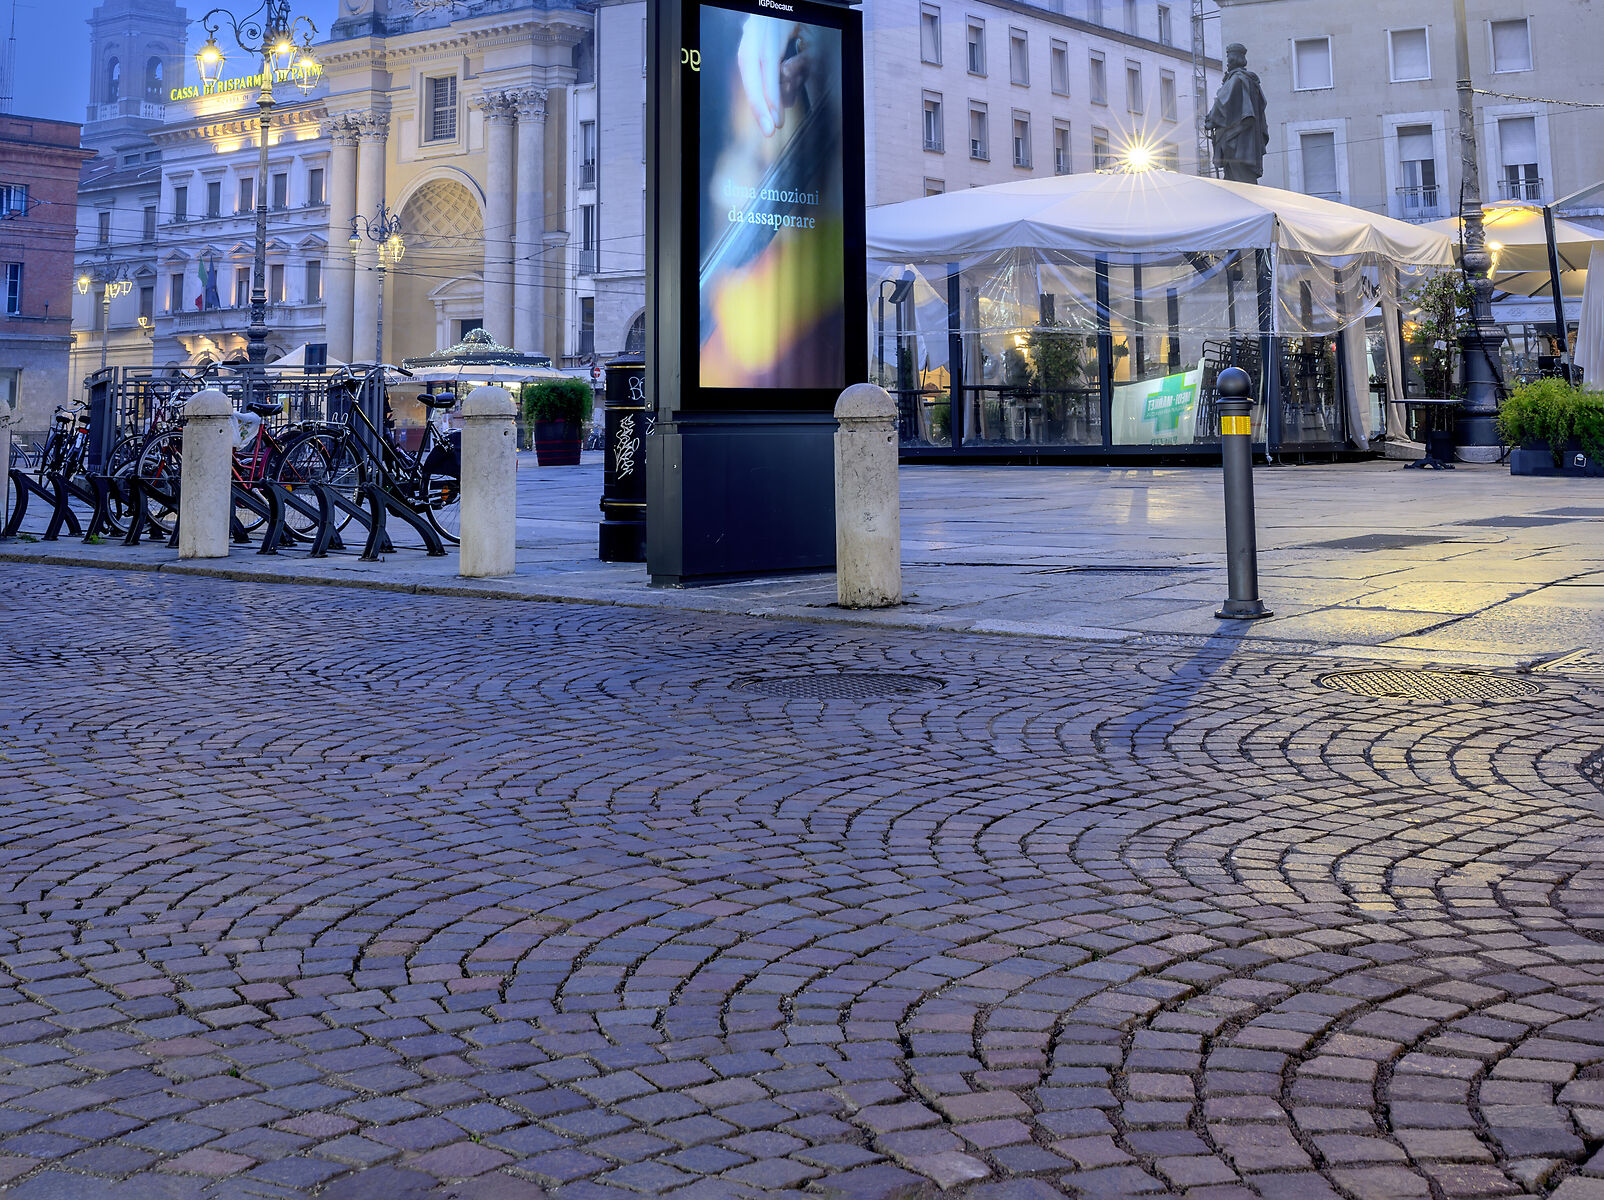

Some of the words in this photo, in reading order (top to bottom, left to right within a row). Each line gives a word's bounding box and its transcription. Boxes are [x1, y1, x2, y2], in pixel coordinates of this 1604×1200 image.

[171, 85, 200, 101] CASSA
[760, 187, 819, 206] emozioni
[727, 205, 744, 223] da
[747, 211, 816, 231] assaporare
